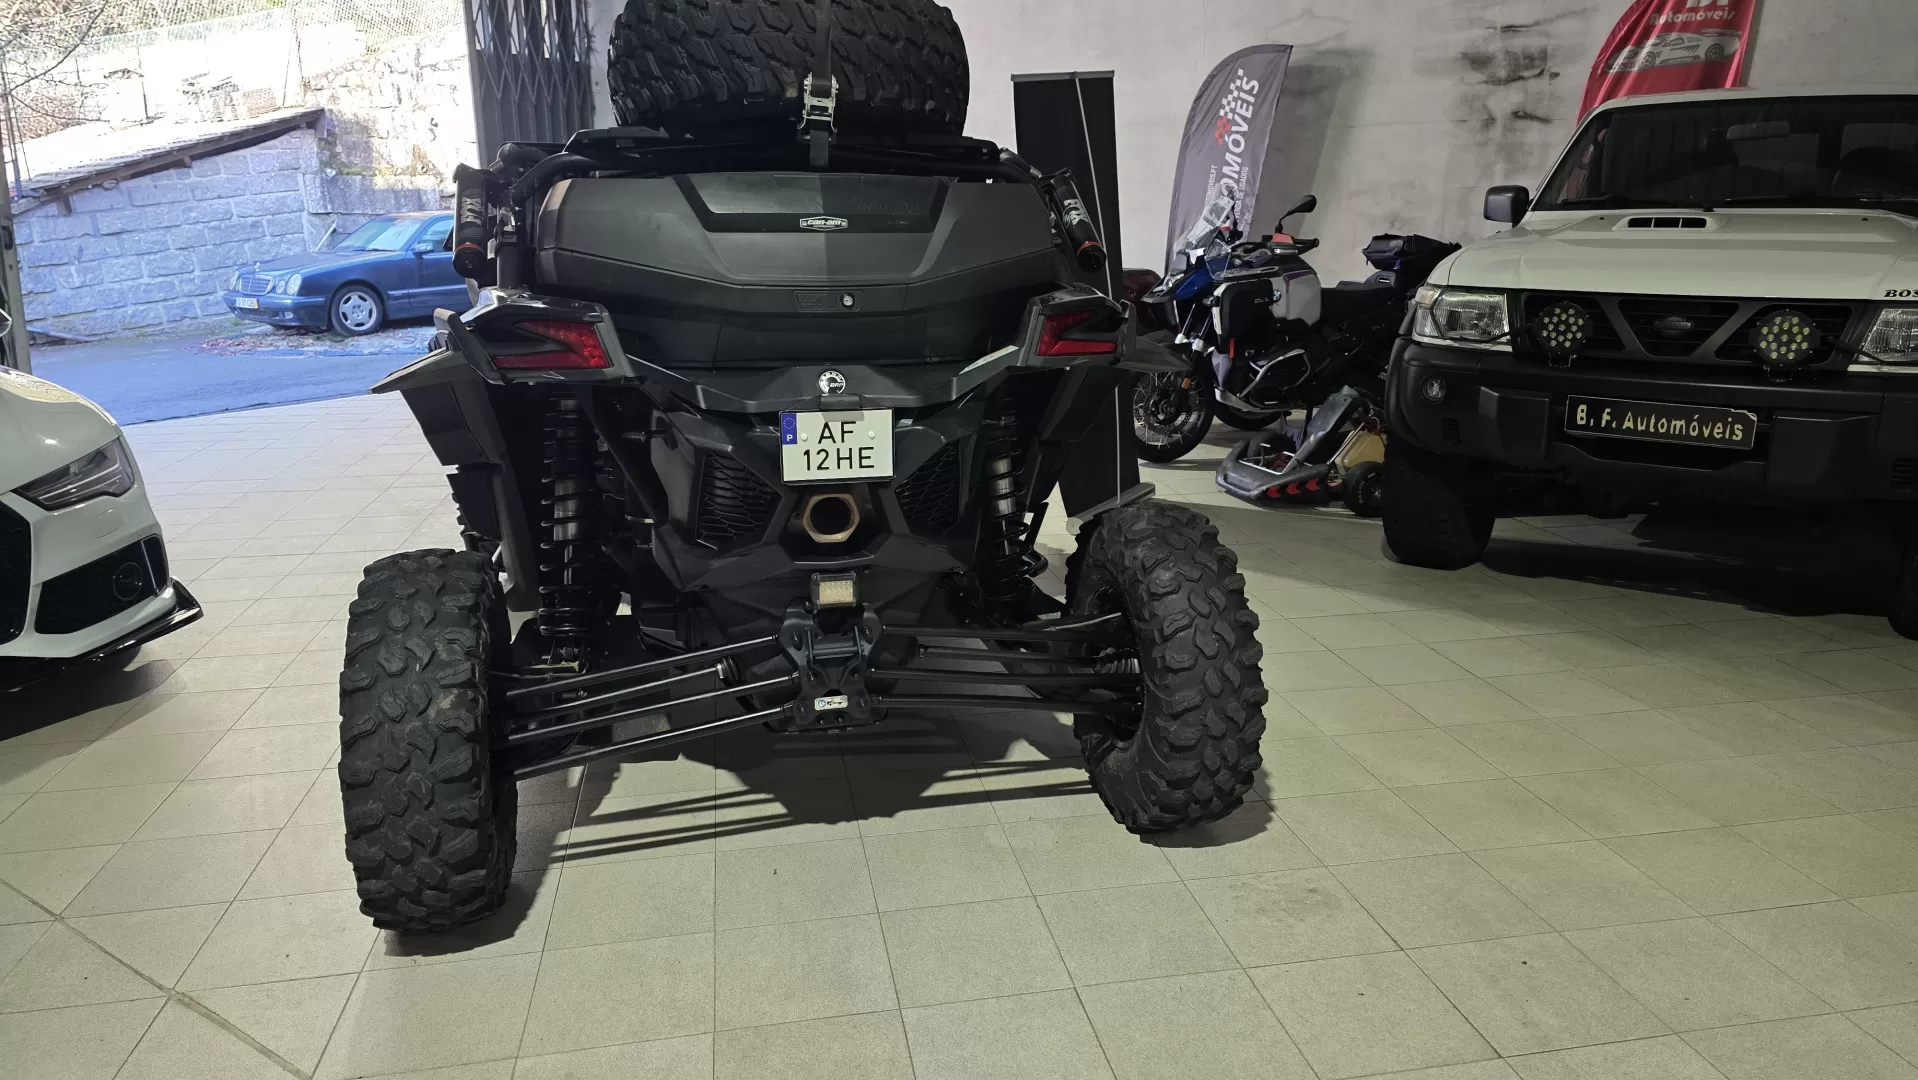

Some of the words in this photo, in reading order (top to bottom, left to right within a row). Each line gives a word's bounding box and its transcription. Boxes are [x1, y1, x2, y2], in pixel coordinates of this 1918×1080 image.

[1220, 77, 1260, 198] OMÓVEIS
[817, 421, 856, 444] AF
[1622, 411, 1744, 441] Automóveis
[803, 447, 875, 471] 12HE
